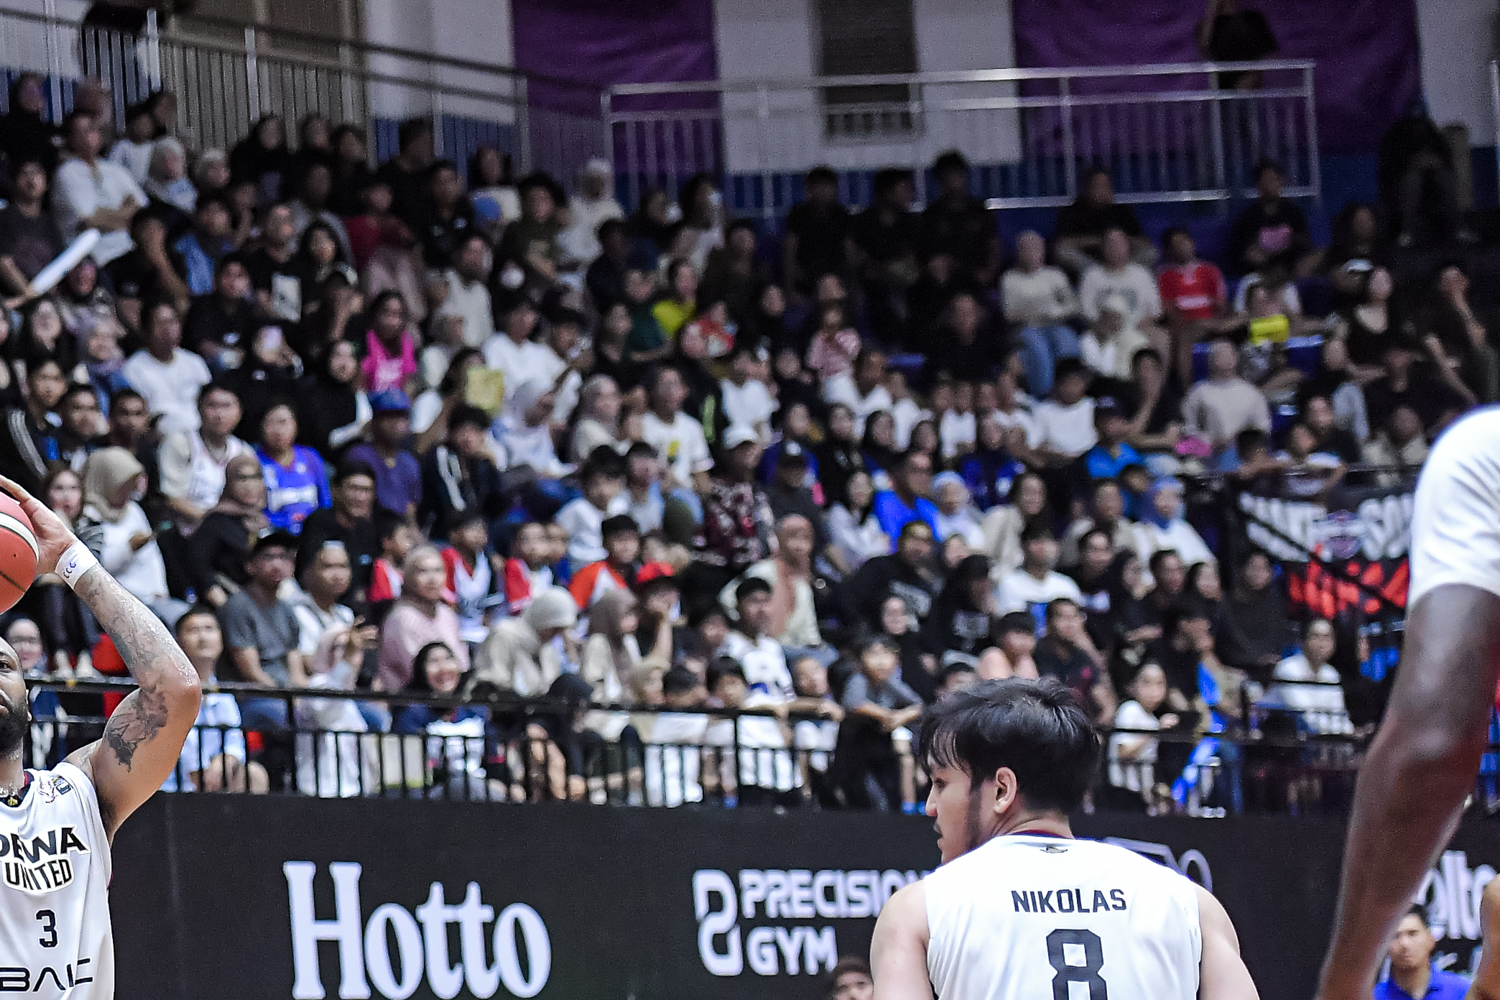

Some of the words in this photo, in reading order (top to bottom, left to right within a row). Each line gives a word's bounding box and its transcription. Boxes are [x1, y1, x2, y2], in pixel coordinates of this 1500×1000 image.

[1010, 888, 1128, 914] NIKOLAS
[35, 909, 59, 948] 3
[282, 860, 552, 1000] Hotto
[746, 925, 839, 976] GYM
